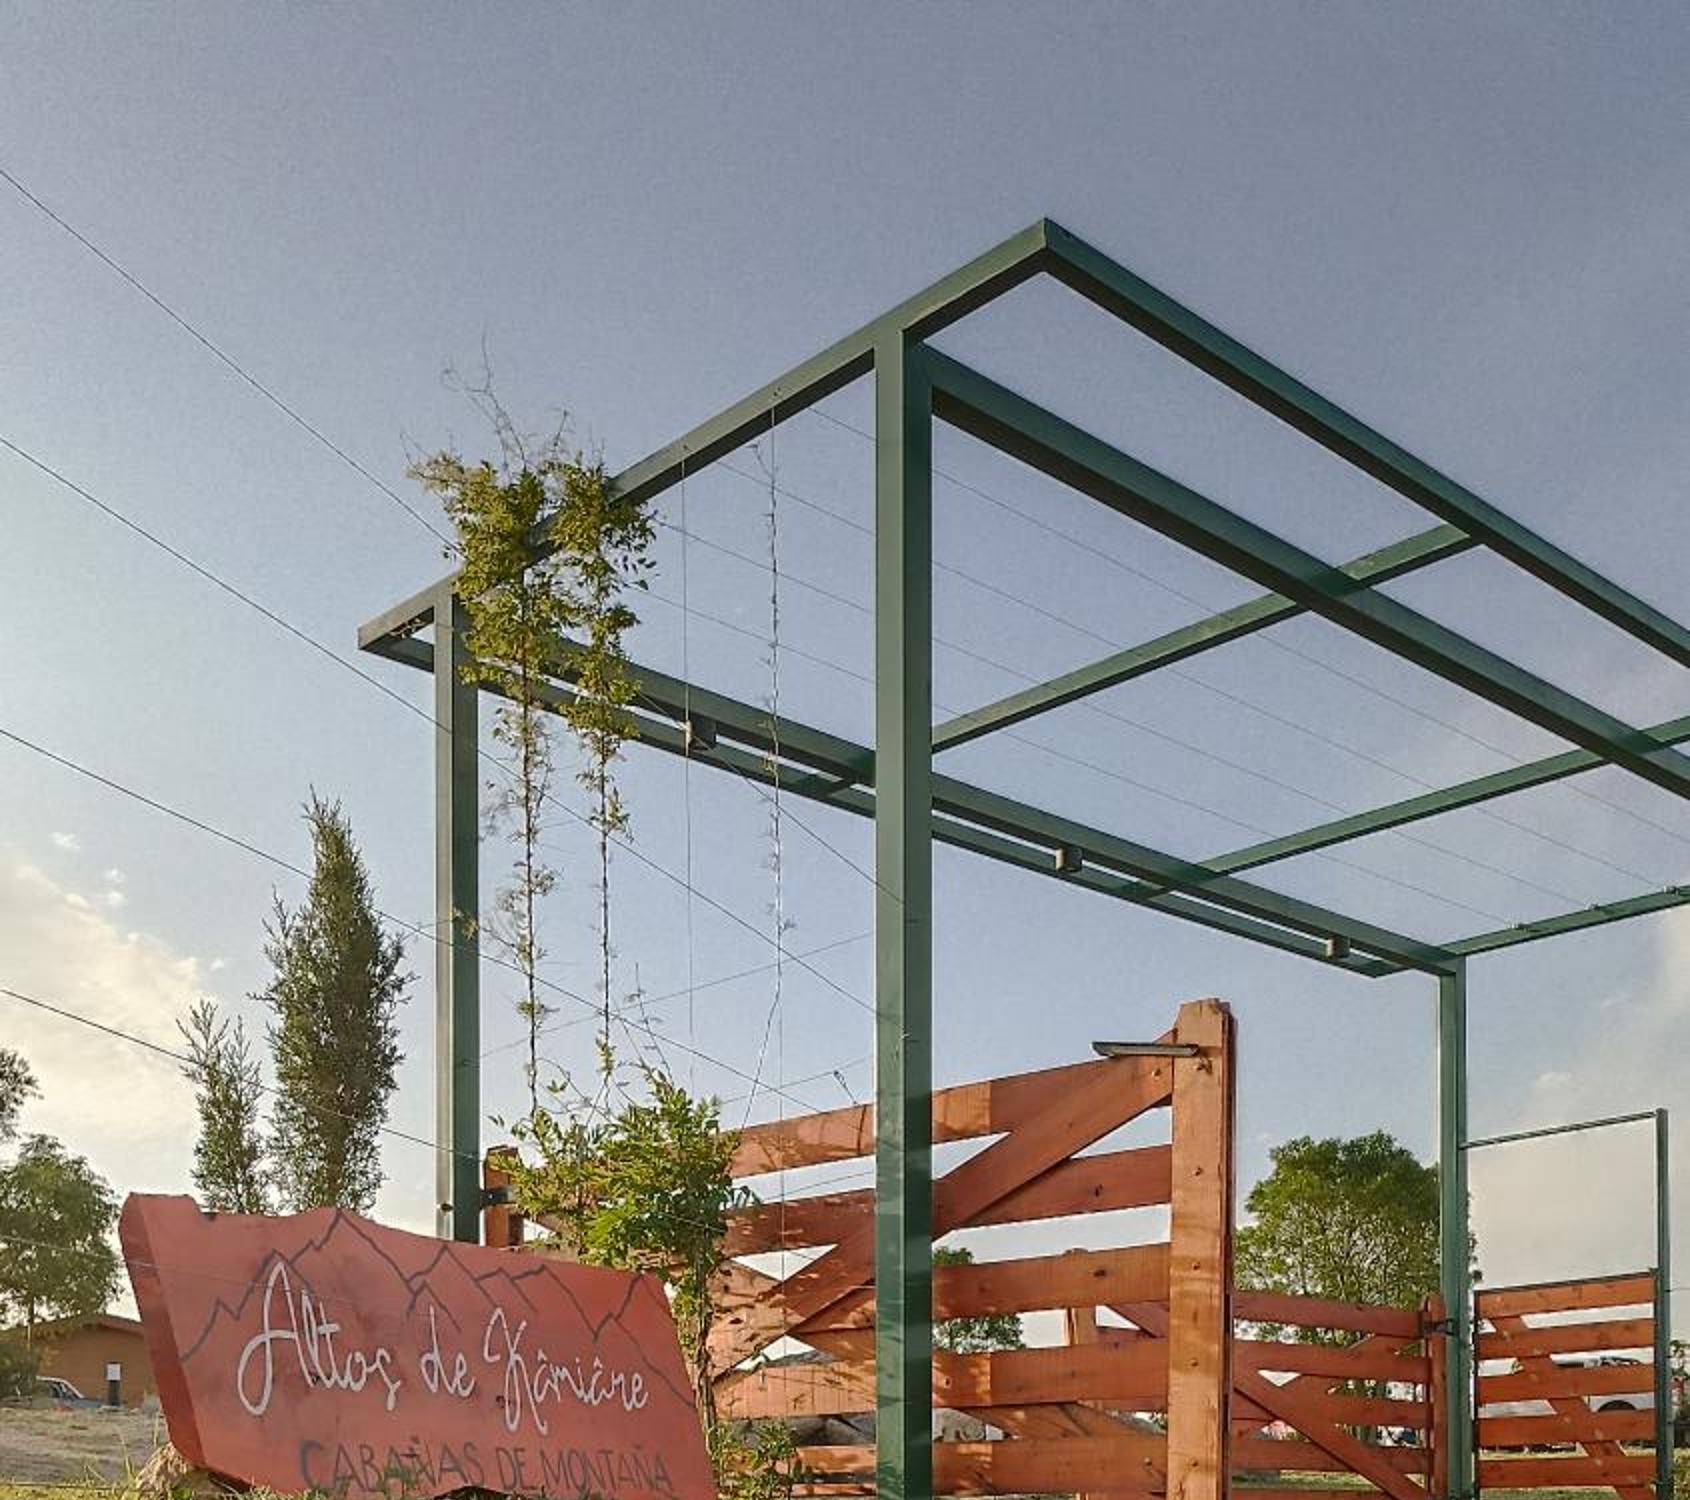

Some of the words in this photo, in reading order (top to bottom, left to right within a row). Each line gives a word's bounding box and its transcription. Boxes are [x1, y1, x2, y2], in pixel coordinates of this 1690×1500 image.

[237, 1261, 401, 1416] Altos
[420, 1304, 476, 1398] de
[495, 1446, 541, 1490] DE
[540, 1443, 673, 1497] MONTAÑA
